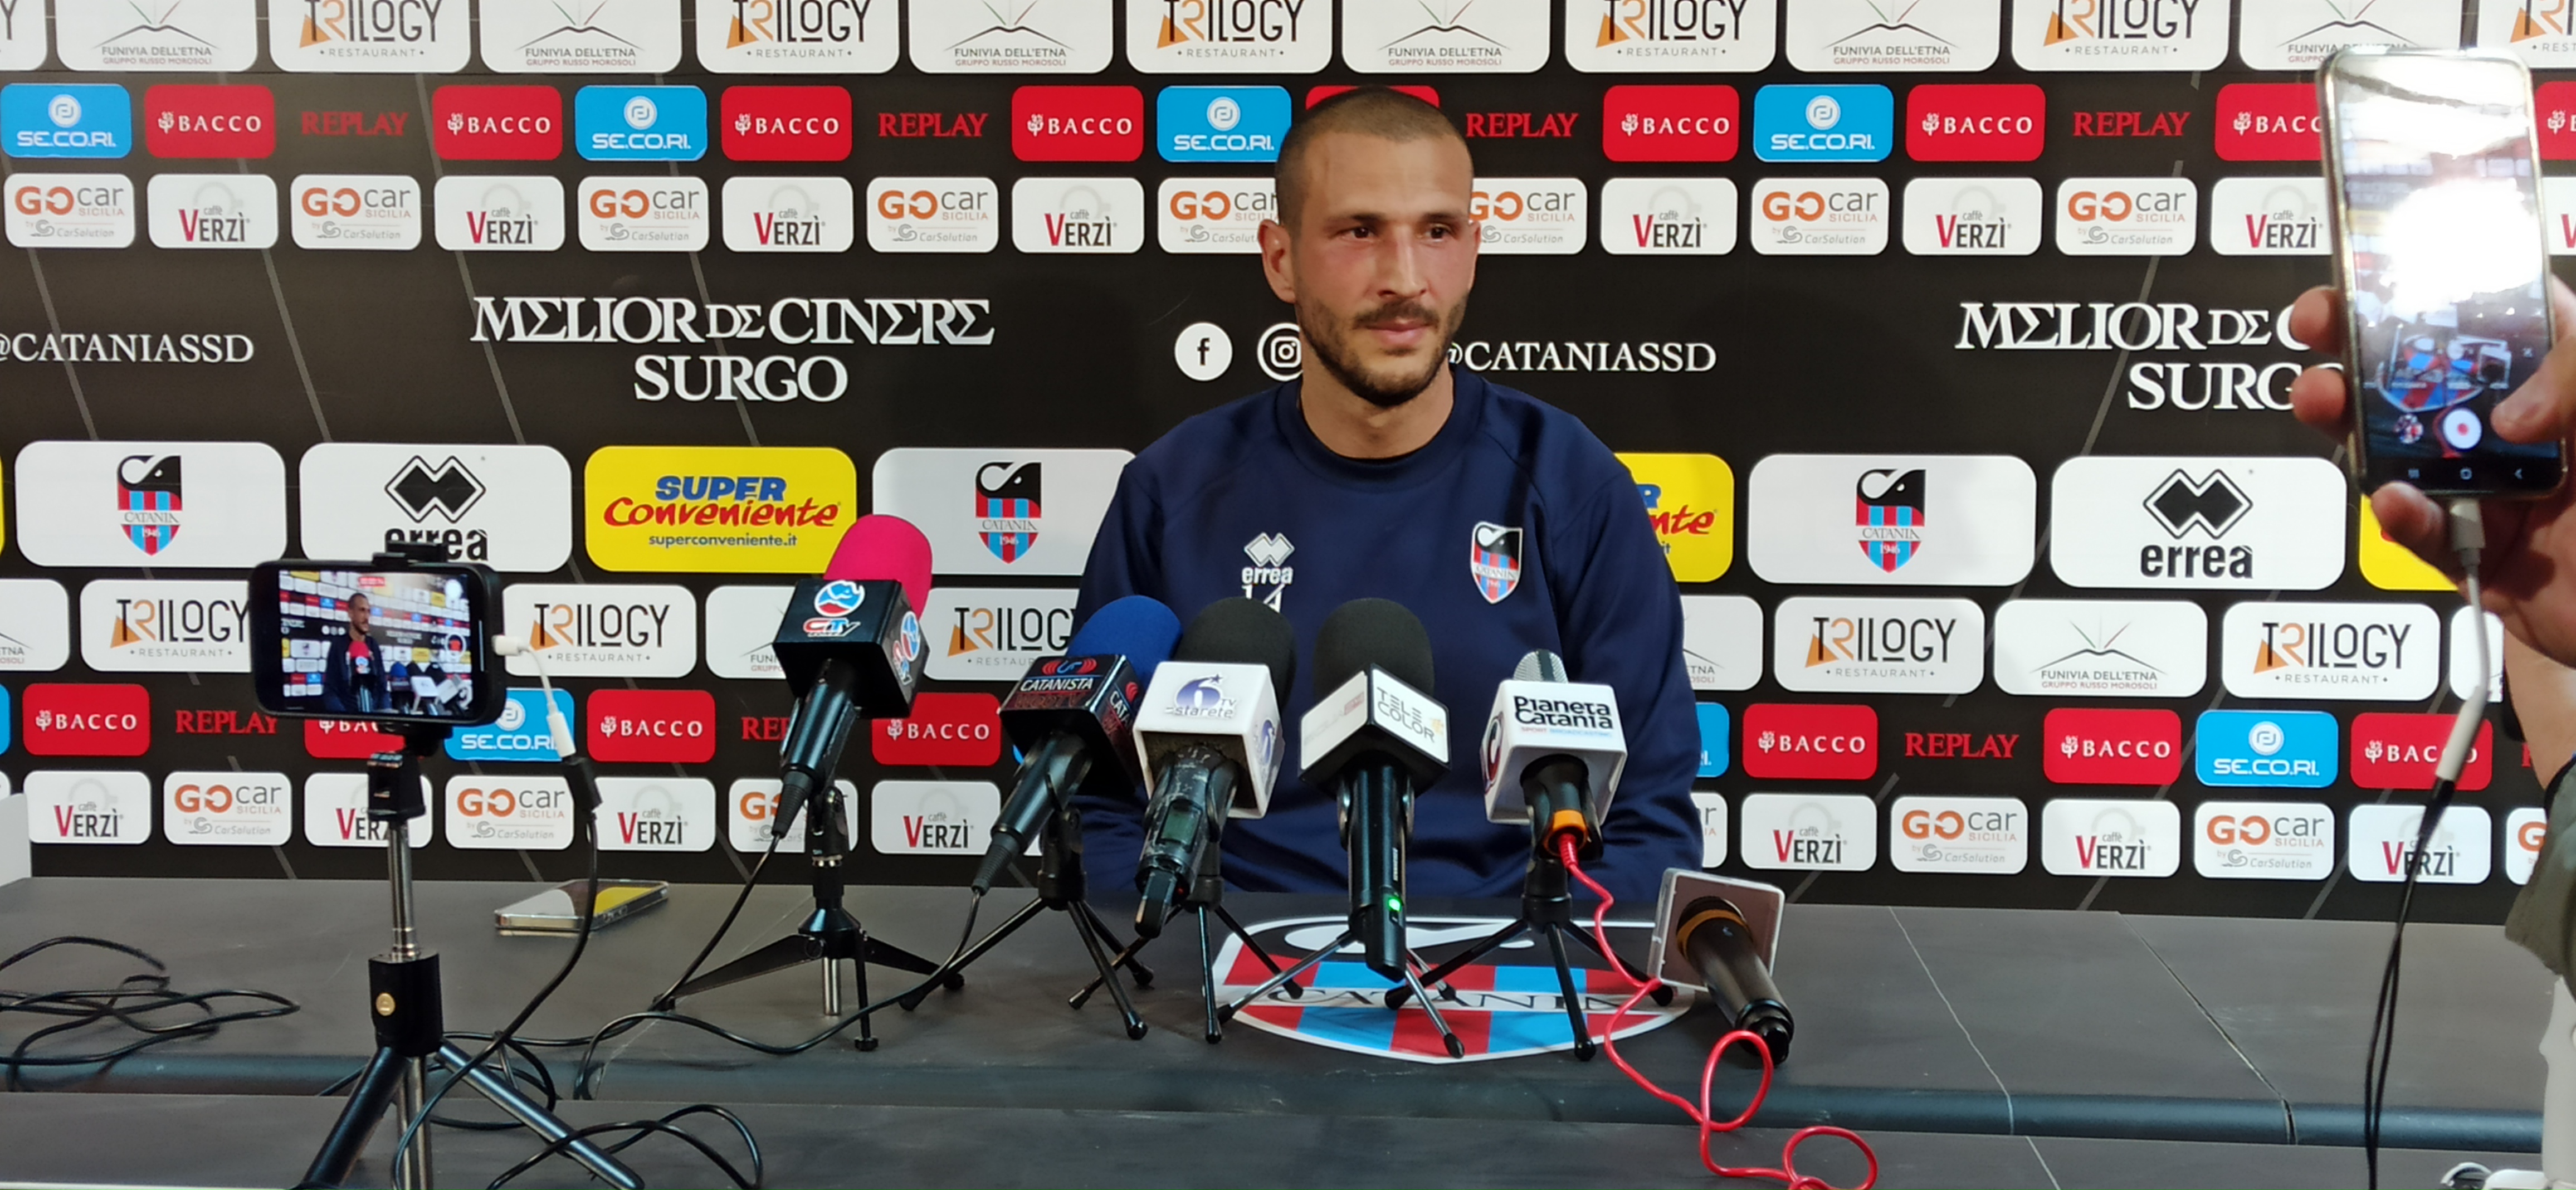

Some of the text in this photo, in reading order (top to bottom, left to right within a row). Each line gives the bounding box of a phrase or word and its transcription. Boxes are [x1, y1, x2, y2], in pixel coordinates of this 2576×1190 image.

[305, 0, 441, 42] TRILOGY
[733, 0, 870, 43] TRILOGY
[1164, 0, 1304, 43] TRILOGY
[1604, 0, 1747, 41] TRILOGY
[102, 46, 212, 56] FUNIVIA DELL'ETNA
[329, 48, 415, 57] RESTAURANT
[526, 48, 636, 57] FUNIVIA DELL'ETNA
[757, 49, 843, 58] RESTAURANT
[955, 48, 1066, 57] FUNIVIA DELL'ETNA
[1187, 48, 1275, 57] RESTAURANT
[1389, 48, 1501, 56] FUNIVIA DELL'ETNA
[1627, 47, 1717, 56] RESTAURANT
[1834, 46, 1950, 55] FUNIVIA DELL'ETNA
[2075, 46, 2168, 55] RESTAURANT
[179, 116, 261, 131] BACCO
[301, 111, 408, 136] REPLAY
[469, 117, 550, 133] BACCO
[756, 118, 838, 134] BACCO
[879, 113, 988, 137] REPLAY
[1048, 118, 1131, 134] BACCO
[1466, 113, 1578, 137] REPLAY
[1643, 118, 1729, 134] BACCO
[1944, 117, 2032, 134] BACCO
[2074, 112, 2190, 136] REPLAY
[79, 207, 124, 216] SICILIA
[365, 209, 411, 218] SICILIA
[654, 211, 700, 220] SICILIA
[942, 212, 988, 220] SICILIA
[1829, 213, 1877, 222] SICILIA
[2136, 213, 2185, 222] SICILIA
[635, 355, 847, 401] SURGO
[2127, 363, 2343, 410] SURG
[655, 476, 787, 501] SUPER
[124, 512, 179, 522] CATANIA
[603, 497, 838, 527] Conveniente
[142, 528, 160, 537] 1946
[983, 520, 1037, 530] CATANIA
[999, 536, 1019, 545] 1946
[1862, 527, 1920, 539] CATANIA
[648, 534, 797, 548] superconveniente.it
[1880, 544, 1901, 554] 1946
[116, 599, 248, 642] TRILOGY
[535, 604, 670, 647] TRILOGY
[954, 608, 1077, 651] TRILOG
[1813, 617, 1956, 663] TRILOGY
[2262, 622, 2411, 669] TRILOGY
[139, 648, 223, 657] RESTAURANT
[557, 653, 642, 662] RESTAURANT
[1836, 668, 1925, 677] RESTAURANT
[2042, 671, 2157, 680] FUNIVIA DELL'ETNA
[2285, 674, 2378, 684] RESTAURANT
[1020, 678, 1094, 691] CATANISTA
[1377, 686, 1422, 723] TELE
[1514, 696, 1612, 716] Pianeta
[56, 714, 136, 729] BACCO
[176, 710, 277, 734] REPLAY
[1378, 701, 1435, 743] COLOR
[1515, 709, 1613, 729] Catania
[621, 720, 702, 736] BACCO
[908, 724, 989, 739] BACCO
[1780, 735, 1865, 753] BACCO
[1905, 733, 2019, 758] REPLAY
[2084, 740, 2170, 758] BACCO
[2388, 745, 2477, 763] BACO
[237, 806, 281, 814] SICILIA
[520, 810, 564, 818] SICILIA
[1969, 832, 2016, 841] SICILIA
[2275, 838, 2324, 847] SICILIA
